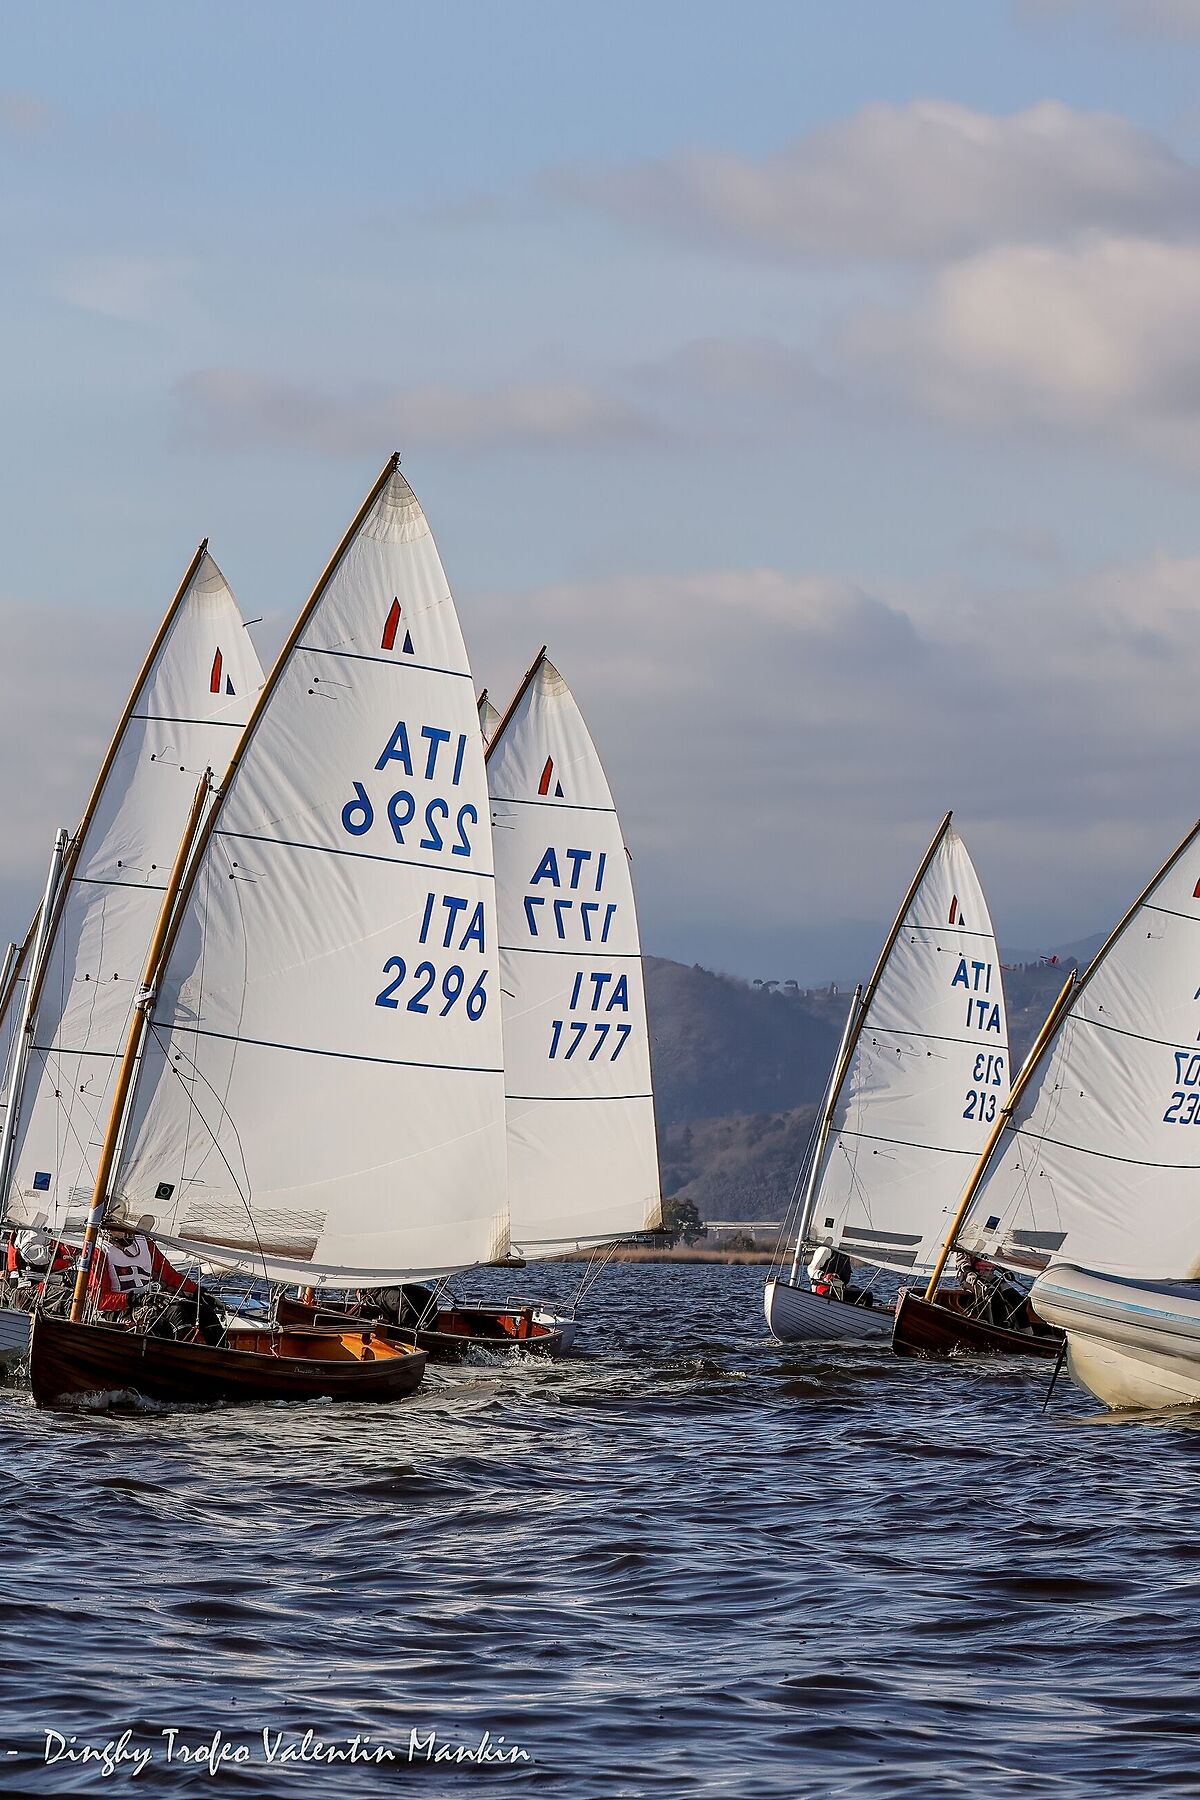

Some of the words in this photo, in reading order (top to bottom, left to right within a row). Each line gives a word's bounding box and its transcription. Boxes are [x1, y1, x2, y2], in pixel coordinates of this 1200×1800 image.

[419, 893, 485, 953] ITA
[375, 956, 489, 1022] 2296
[569, 972, 629, 1012] ITA
[966, 998, 1001, 1033] ITA
[548, 1020, 632, 1062] 1777
[962, 1090, 996, 1123] 213
